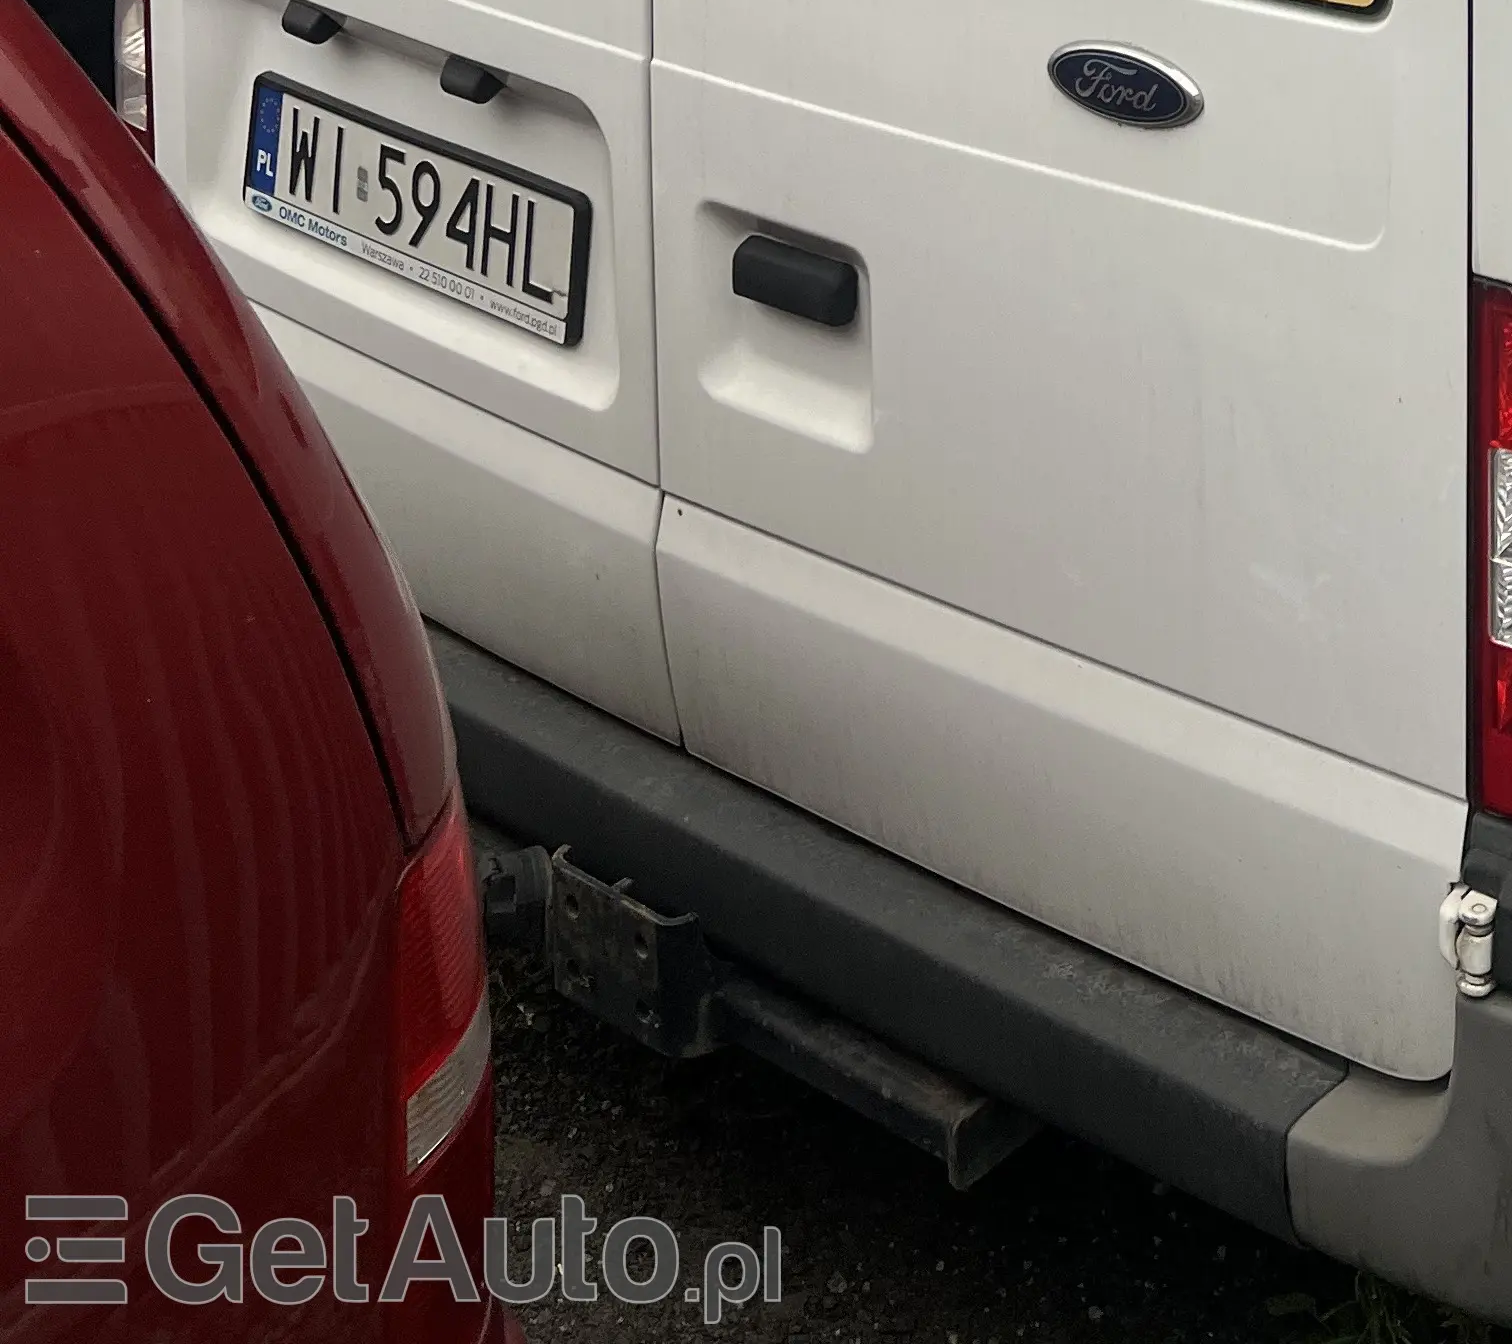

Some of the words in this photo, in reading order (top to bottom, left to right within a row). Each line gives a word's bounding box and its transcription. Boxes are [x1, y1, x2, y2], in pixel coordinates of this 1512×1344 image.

[1074, 58, 1160, 112] Ford
[256, 149, 274, 178] PL
[288, 106, 346, 215] WI
[374, 143, 554, 305] 594HL
[278, 206, 306, 228] OMC
[307, 218, 348, 247] Motors
[360, 240, 405, 271] Warszawa
